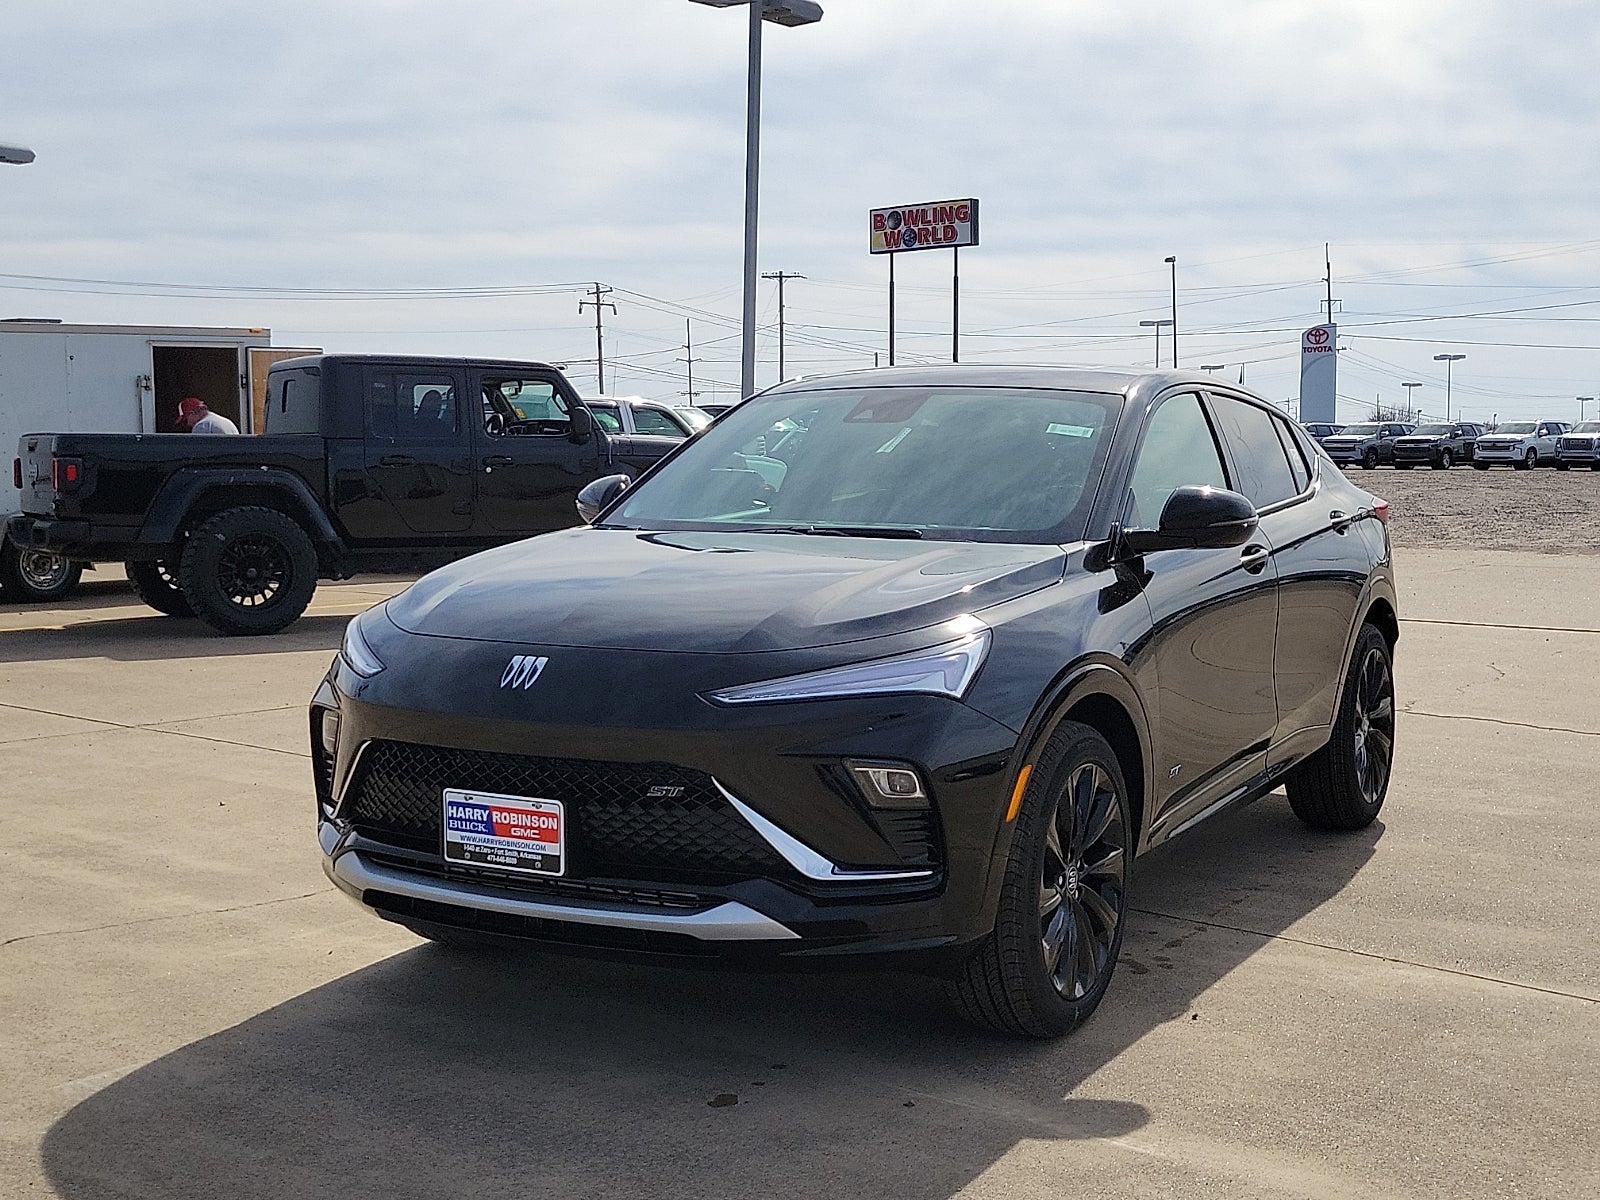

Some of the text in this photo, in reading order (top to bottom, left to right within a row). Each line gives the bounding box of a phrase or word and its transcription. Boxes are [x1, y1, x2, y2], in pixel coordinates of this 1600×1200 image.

[873, 204, 970, 232] BOWLING
[883, 225, 958, 249] WORLD
[1302, 345, 1333, 353] TOYOTA
[646, 785, 685, 797] ST
[448, 805, 558, 830] HARRY ROBINSON
[448, 819, 489, 833] BUICK
[510, 827, 541, 838] GMC
[459, 834, 547, 852] WWW.HARRYROBINSON.COM
